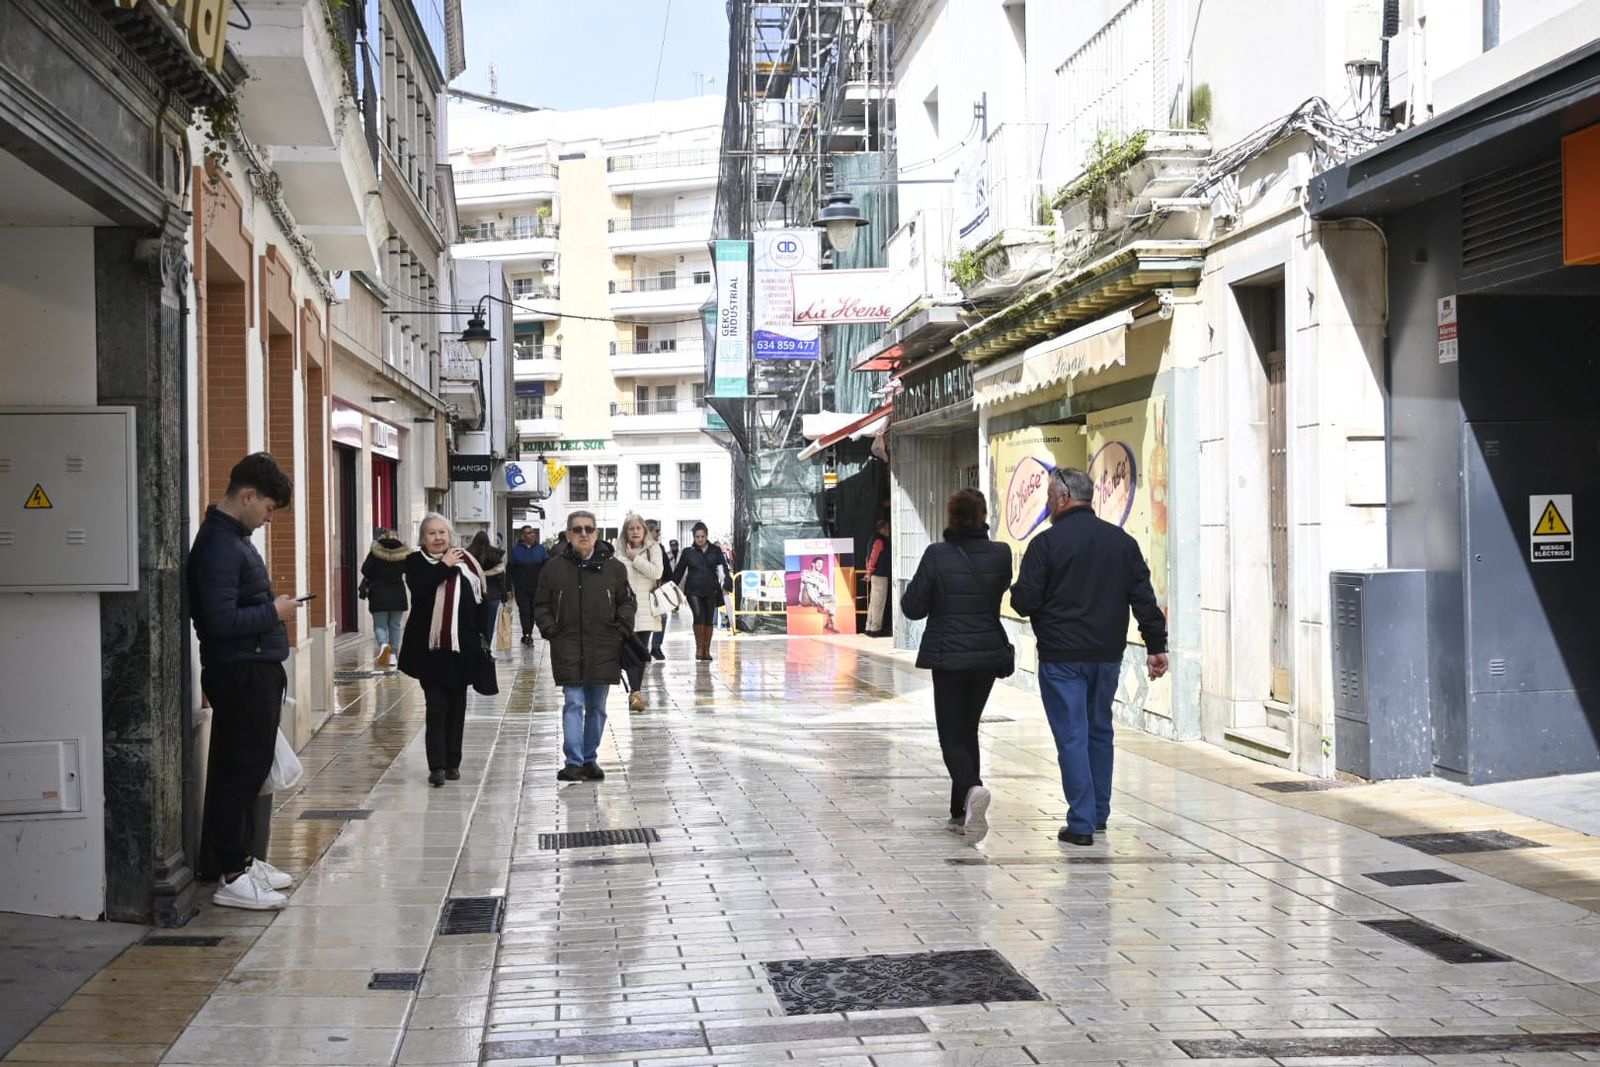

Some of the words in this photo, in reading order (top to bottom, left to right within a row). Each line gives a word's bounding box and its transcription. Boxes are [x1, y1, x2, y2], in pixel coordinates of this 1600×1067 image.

[730, 276, 738, 337] INDUSTRIAL
[721, 308, 730, 337] GEKO
[756, 340, 775, 350] 634
[777, 340, 795, 350] 859
[797, 341, 815, 351] 477
[523, 441, 558, 452] RURAL
[560, 440, 581, 451] DEL
[583, 439, 605, 450] SUR
[452, 464, 488, 472] MANGO
